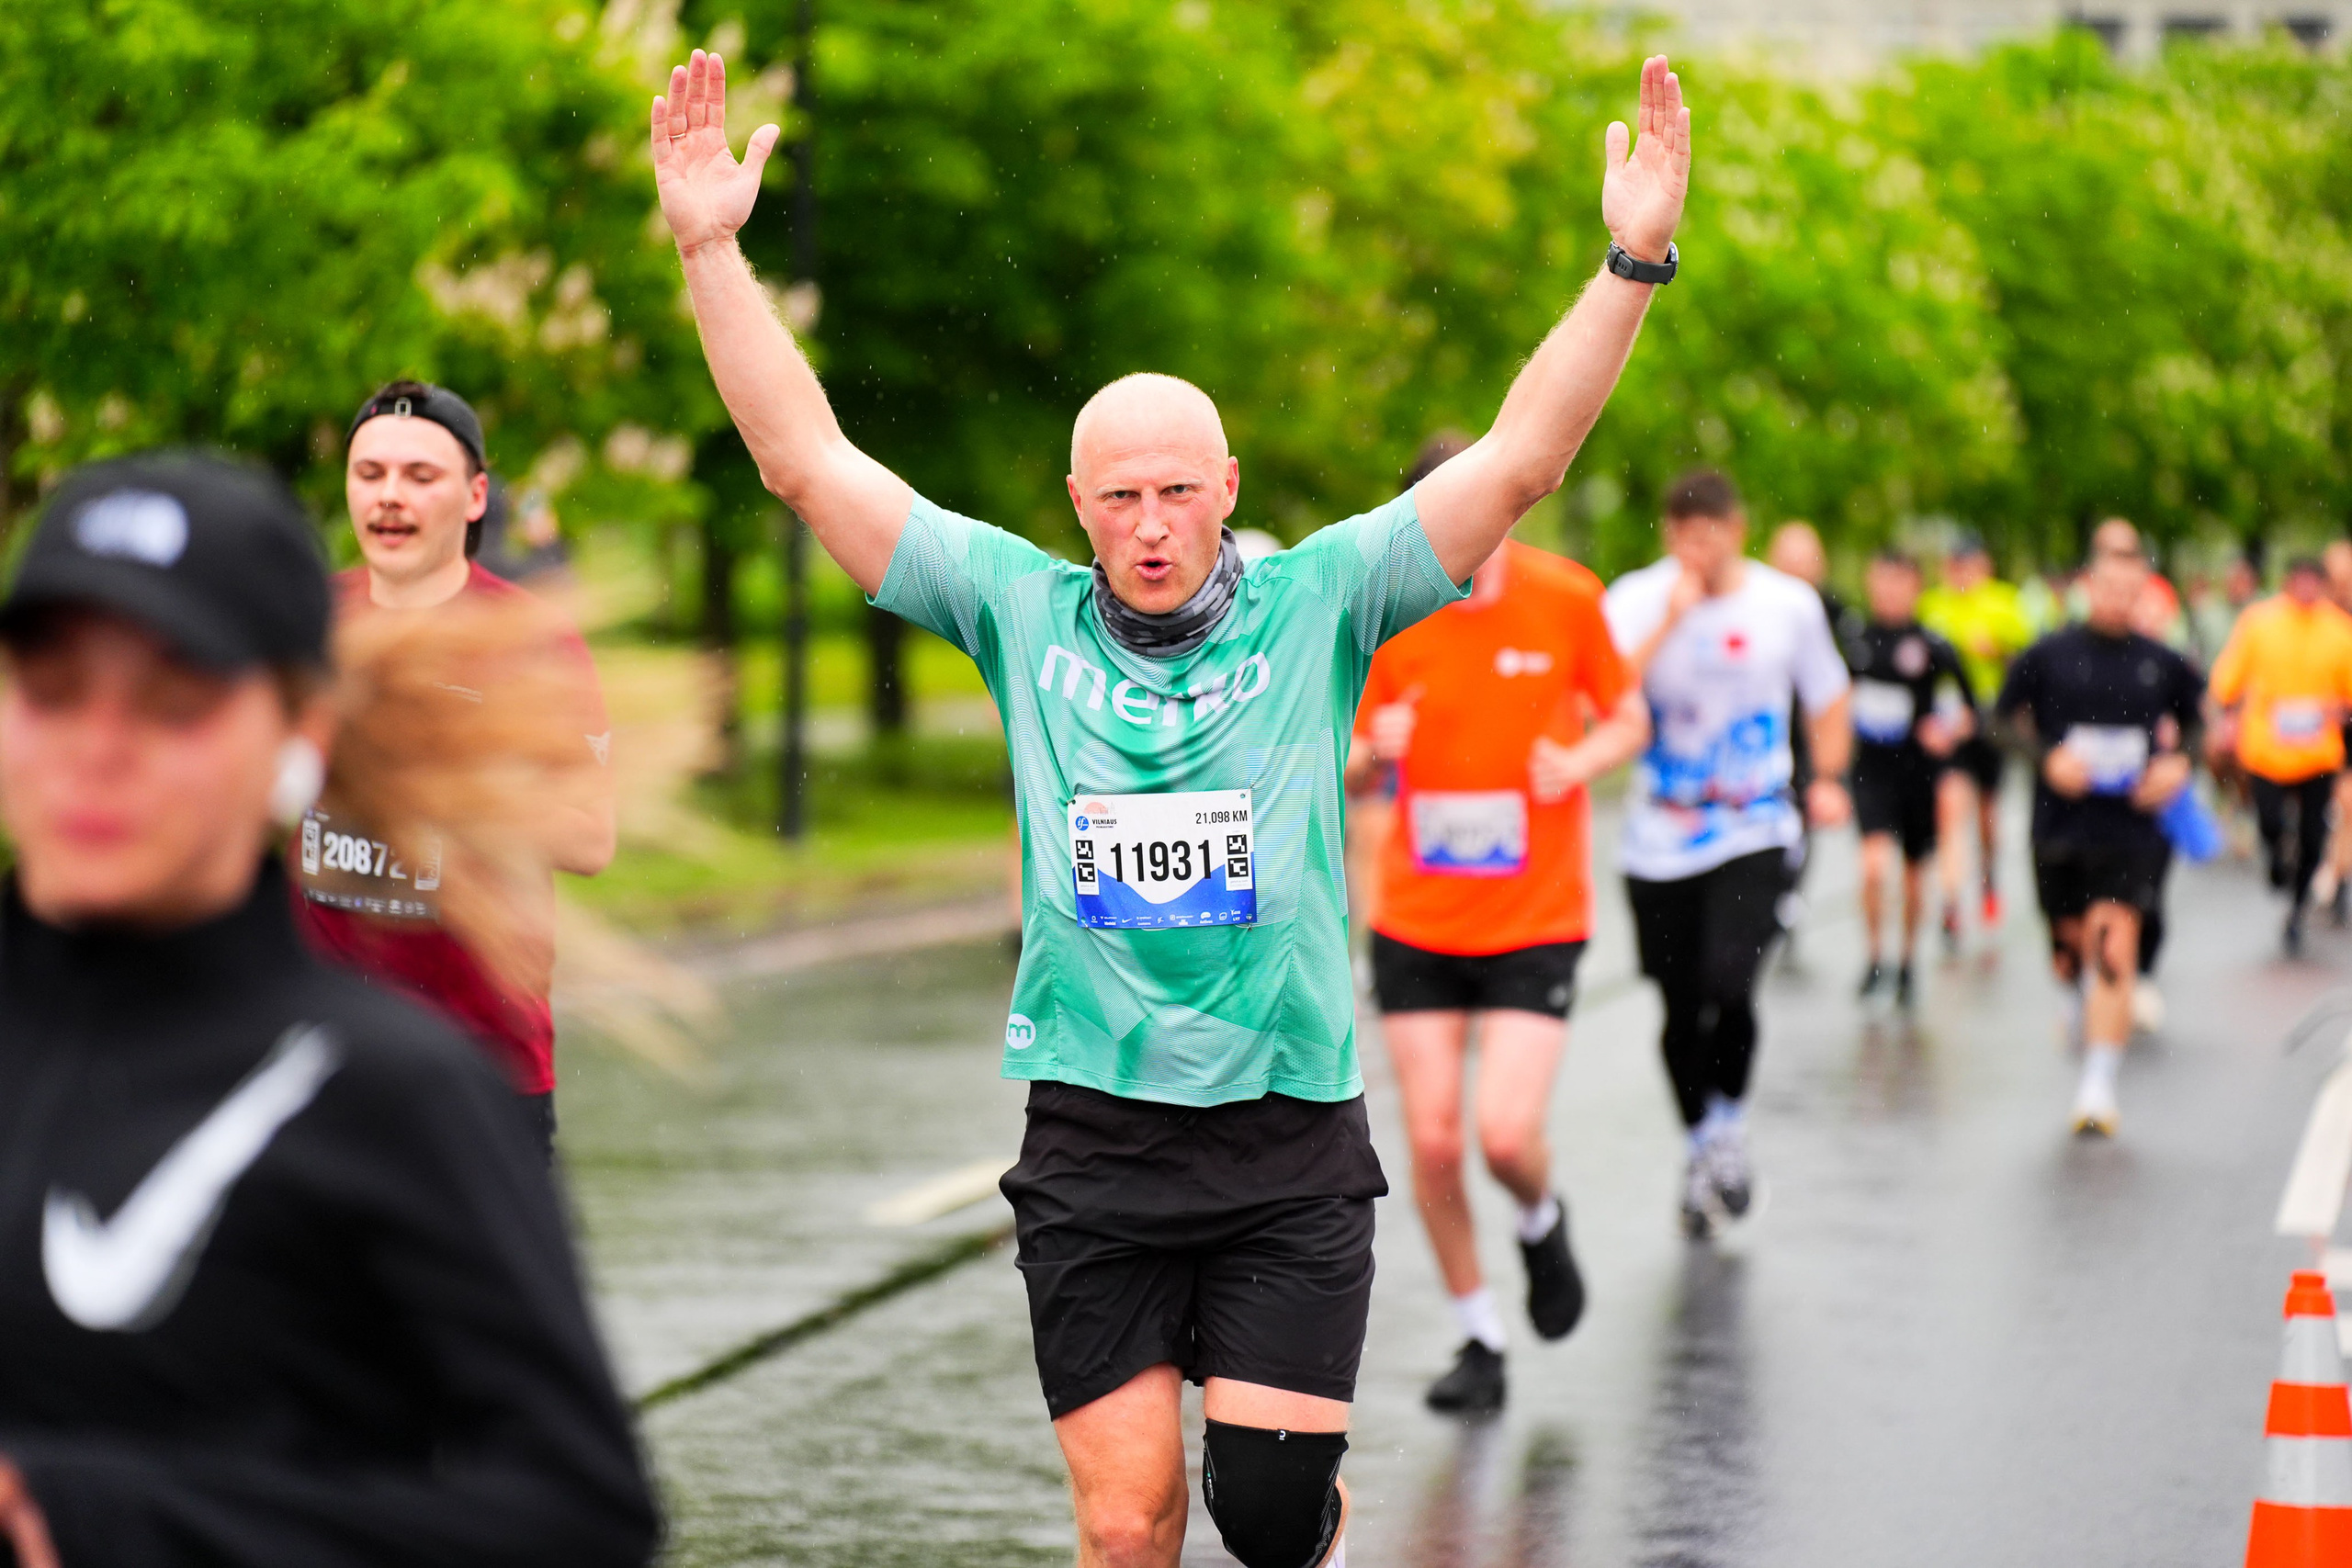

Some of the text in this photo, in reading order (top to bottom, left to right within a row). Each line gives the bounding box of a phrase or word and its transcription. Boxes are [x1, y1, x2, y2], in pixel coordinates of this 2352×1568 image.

[1037, 644, 1272, 727] merko
[1232, 810, 1248, 822] KM
[1110, 840, 1212, 883] 11931
